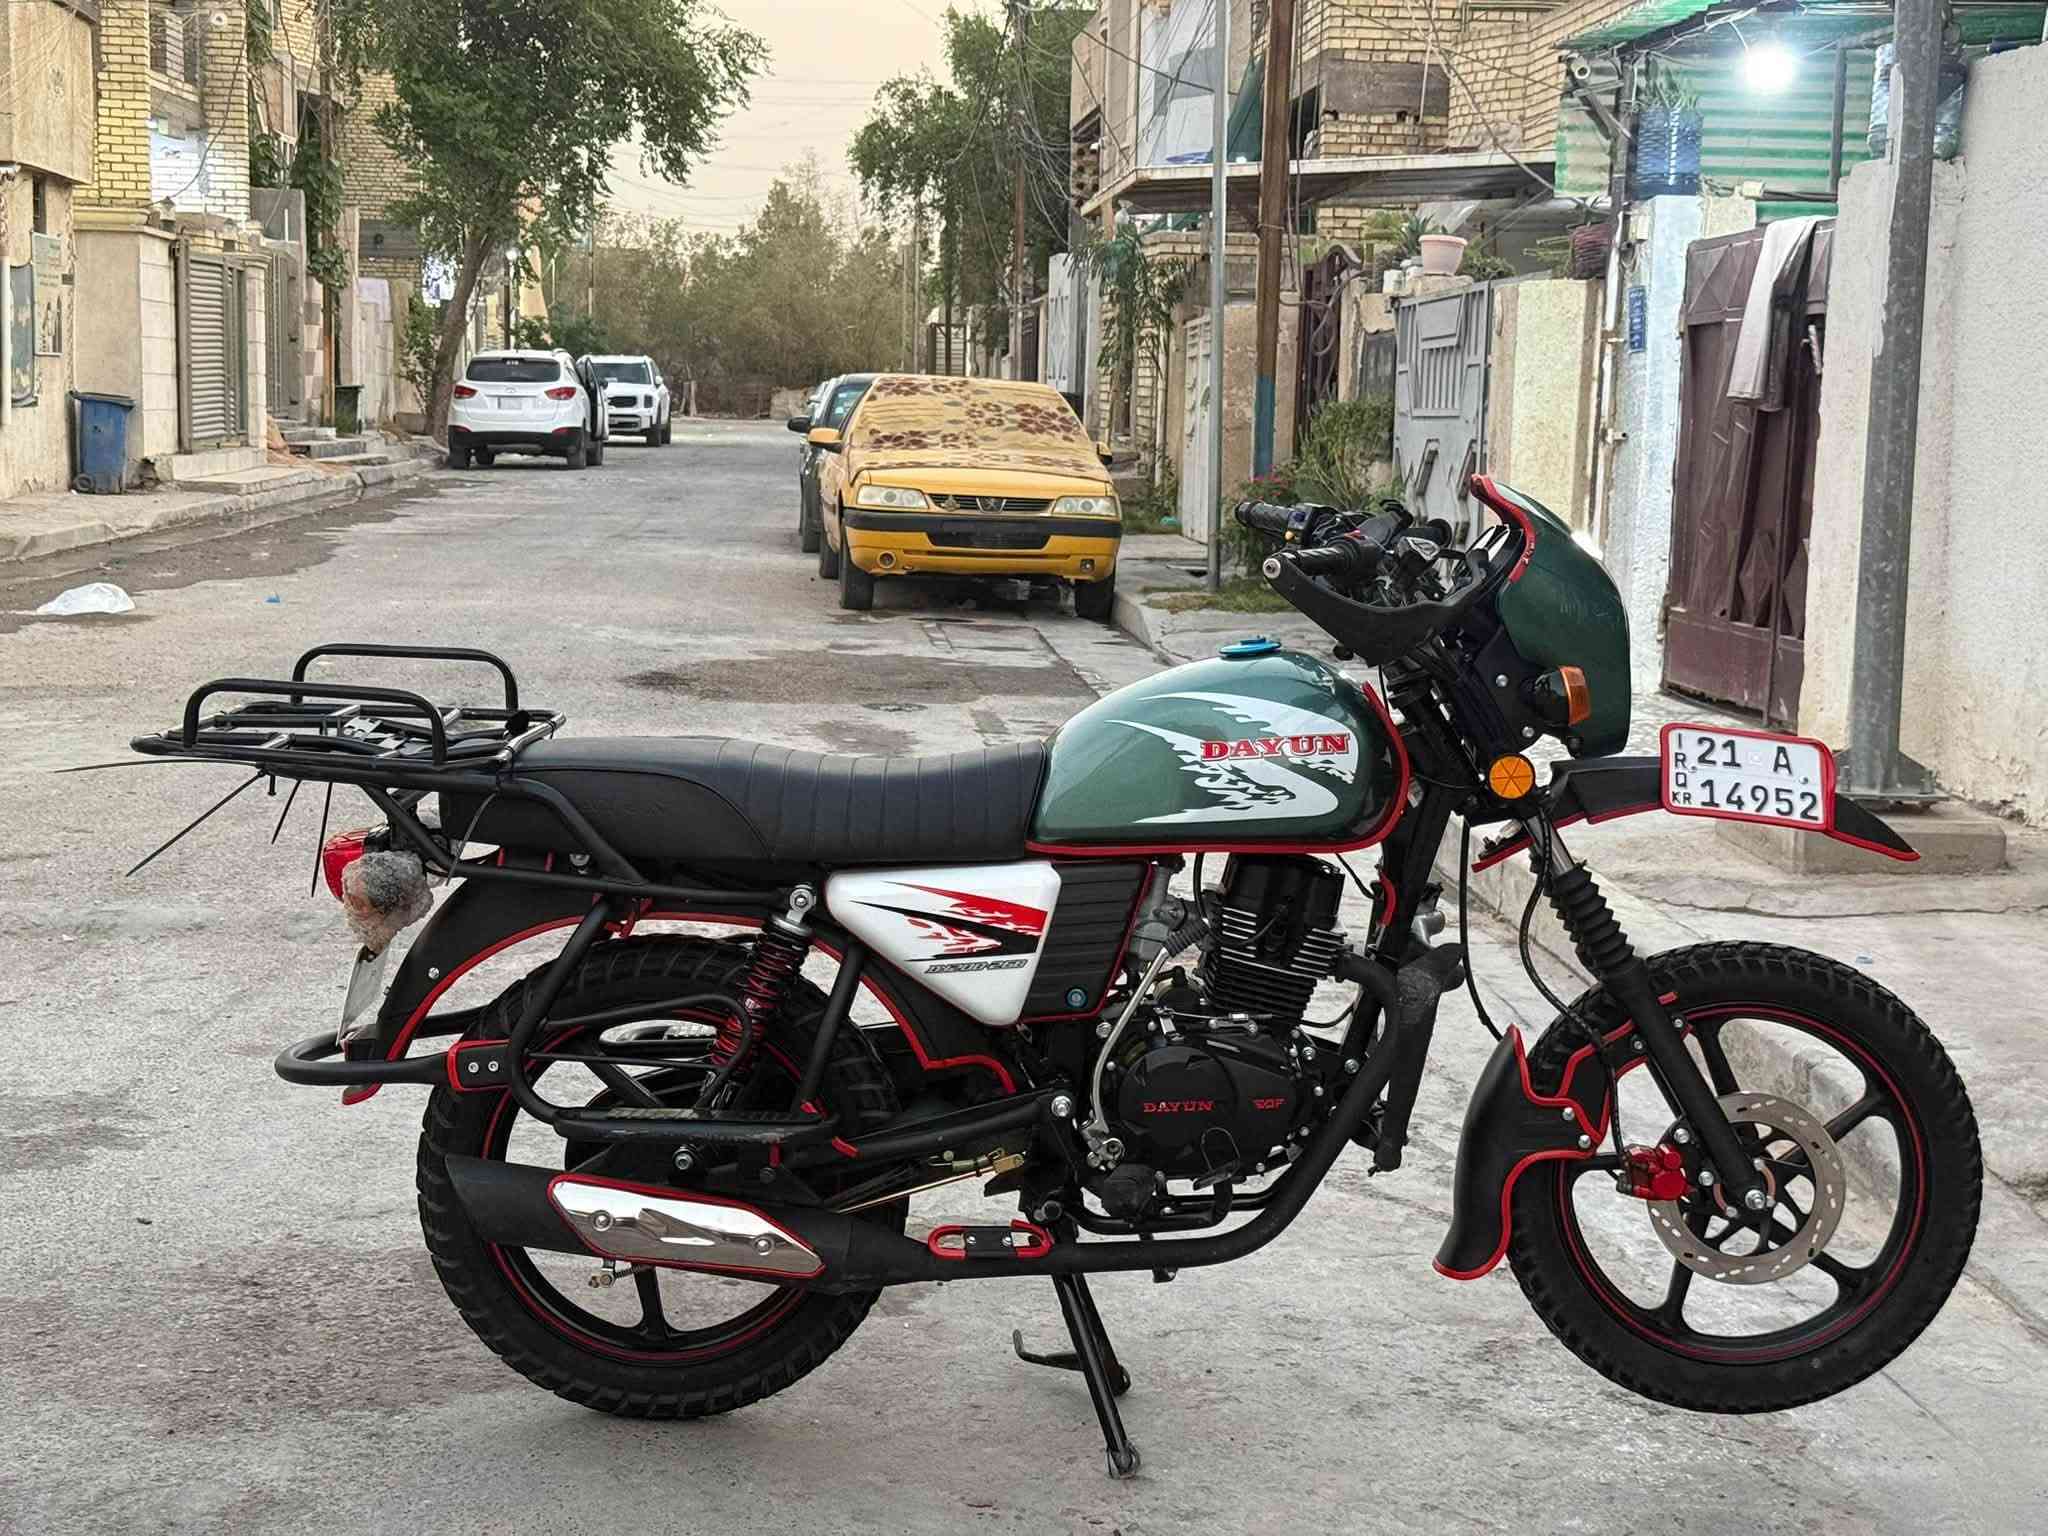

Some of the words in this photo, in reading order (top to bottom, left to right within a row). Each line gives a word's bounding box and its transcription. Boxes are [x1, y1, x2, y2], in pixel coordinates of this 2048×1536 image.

[1200, 732, 1350, 762] DAYUN
[1697, 736, 1741, 768] 21
[1773, 746, 1793, 775] A
[1700, 779, 1819, 821] 14952
[1143, 1099, 1215, 1113] DAYUN
